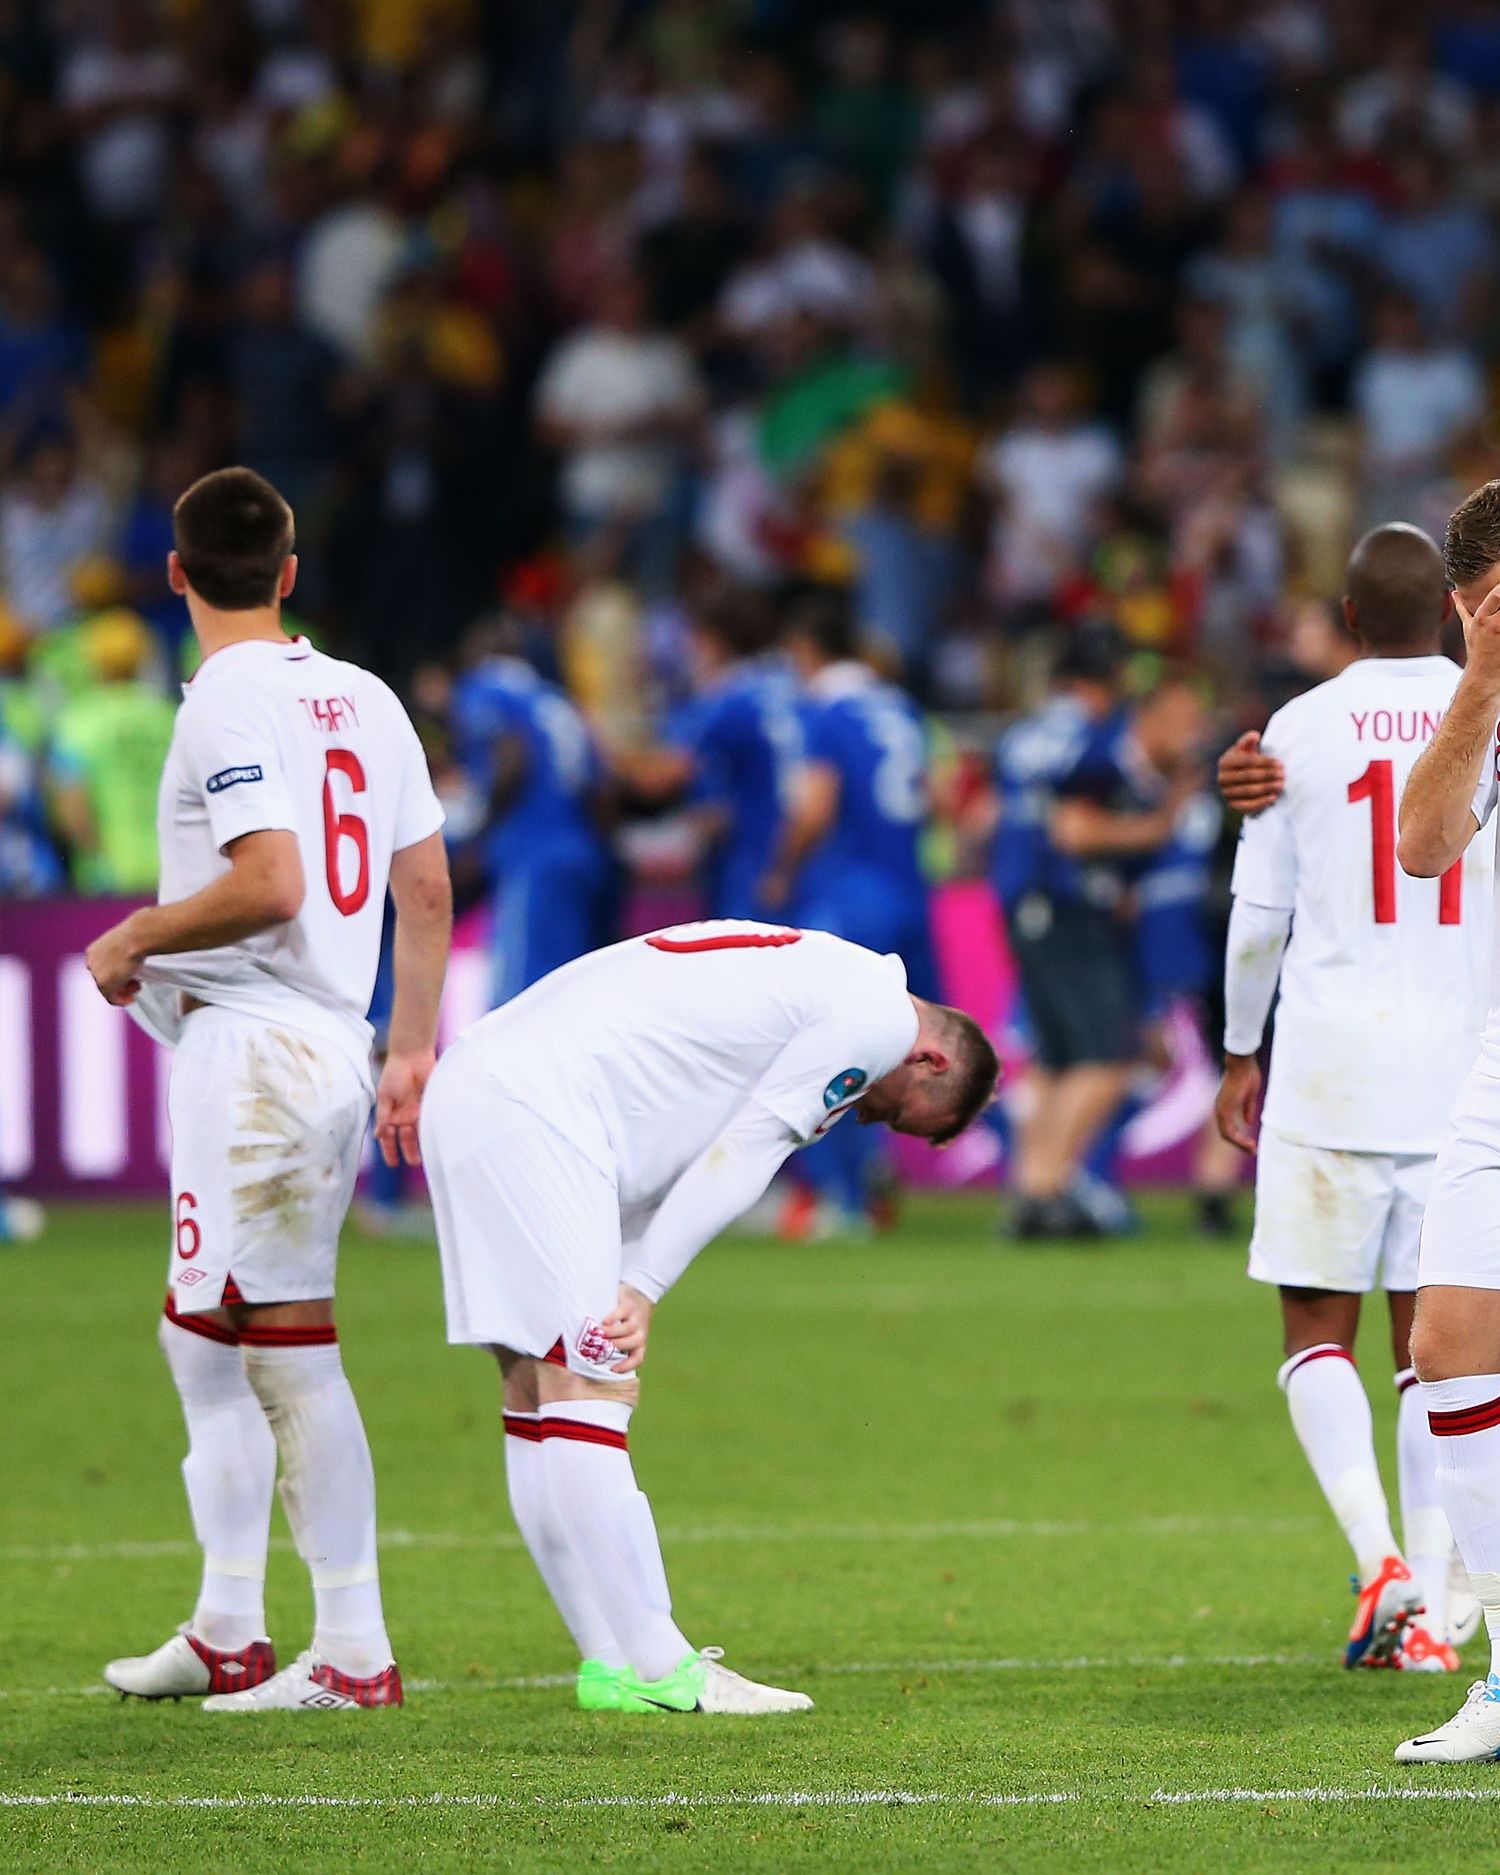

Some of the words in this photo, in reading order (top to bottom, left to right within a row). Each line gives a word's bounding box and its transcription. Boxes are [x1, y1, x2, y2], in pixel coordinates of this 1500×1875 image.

[1350, 711, 1442, 743] YOUN
[321, 748, 372, 918] 6
[175, 1191, 202, 1261] 6
